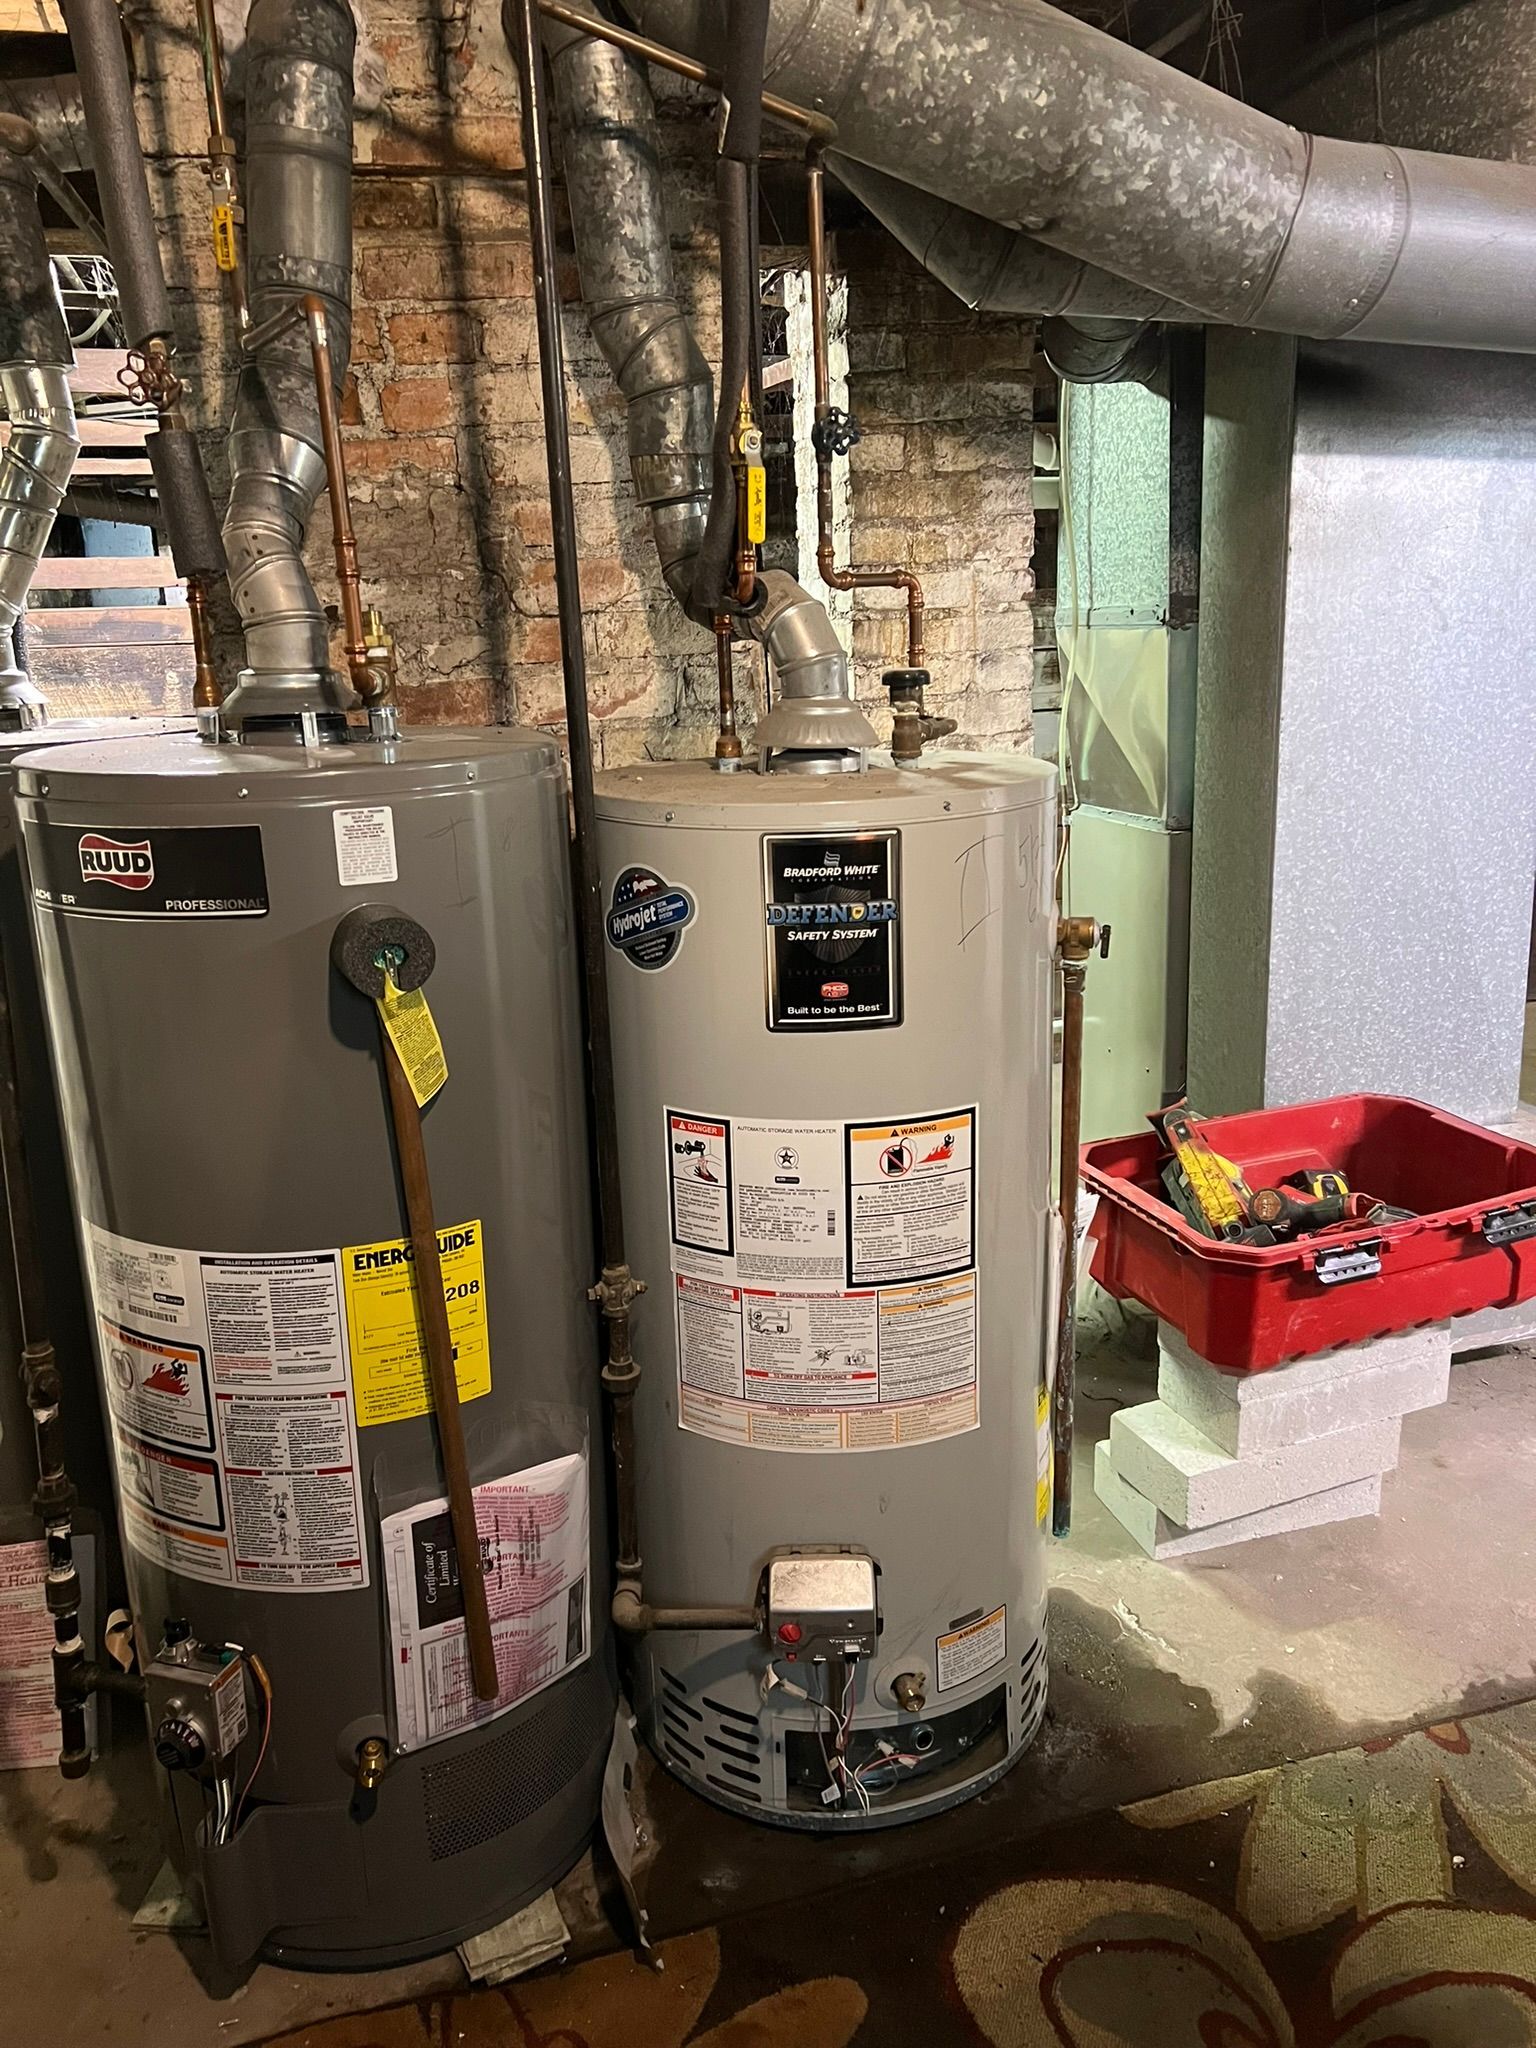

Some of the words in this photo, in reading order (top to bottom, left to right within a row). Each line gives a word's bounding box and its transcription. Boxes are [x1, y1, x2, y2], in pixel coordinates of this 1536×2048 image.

[80, 850, 152, 873] RUUD
[783, 866, 842, 878] BRADFORD
[843, 865, 879, 876] WHITE
[165, 899, 264, 911] PROFESSIONAL
[768, 900, 898, 925] DEFENDER
[612, 904, 657, 938] Hydrojet
[787, 930, 831, 941] SAFETY
[831, 928, 879, 940] SYSTEM
[787, 1006, 809, 1014] Built
[811, 1006, 822, 1015] to
[823, 1004, 837, 1014] be
[839, 1003, 856, 1012] the
[857, 1003, 881, 1012] Best
[687, 1123, 718, 1135] DANGER
[900, 1124, 938, 1135] WARNING
[445, 1279, 480, 1302] 208
[480, 1485, 529, 1493] IMPORTANT
[421, 1541, 436, 1553] of
[437, 1550, 451, 1586] Limited
[424, 1555, 438, 1604] Certificate
[963, 1619, 991, 1636] WARNING
